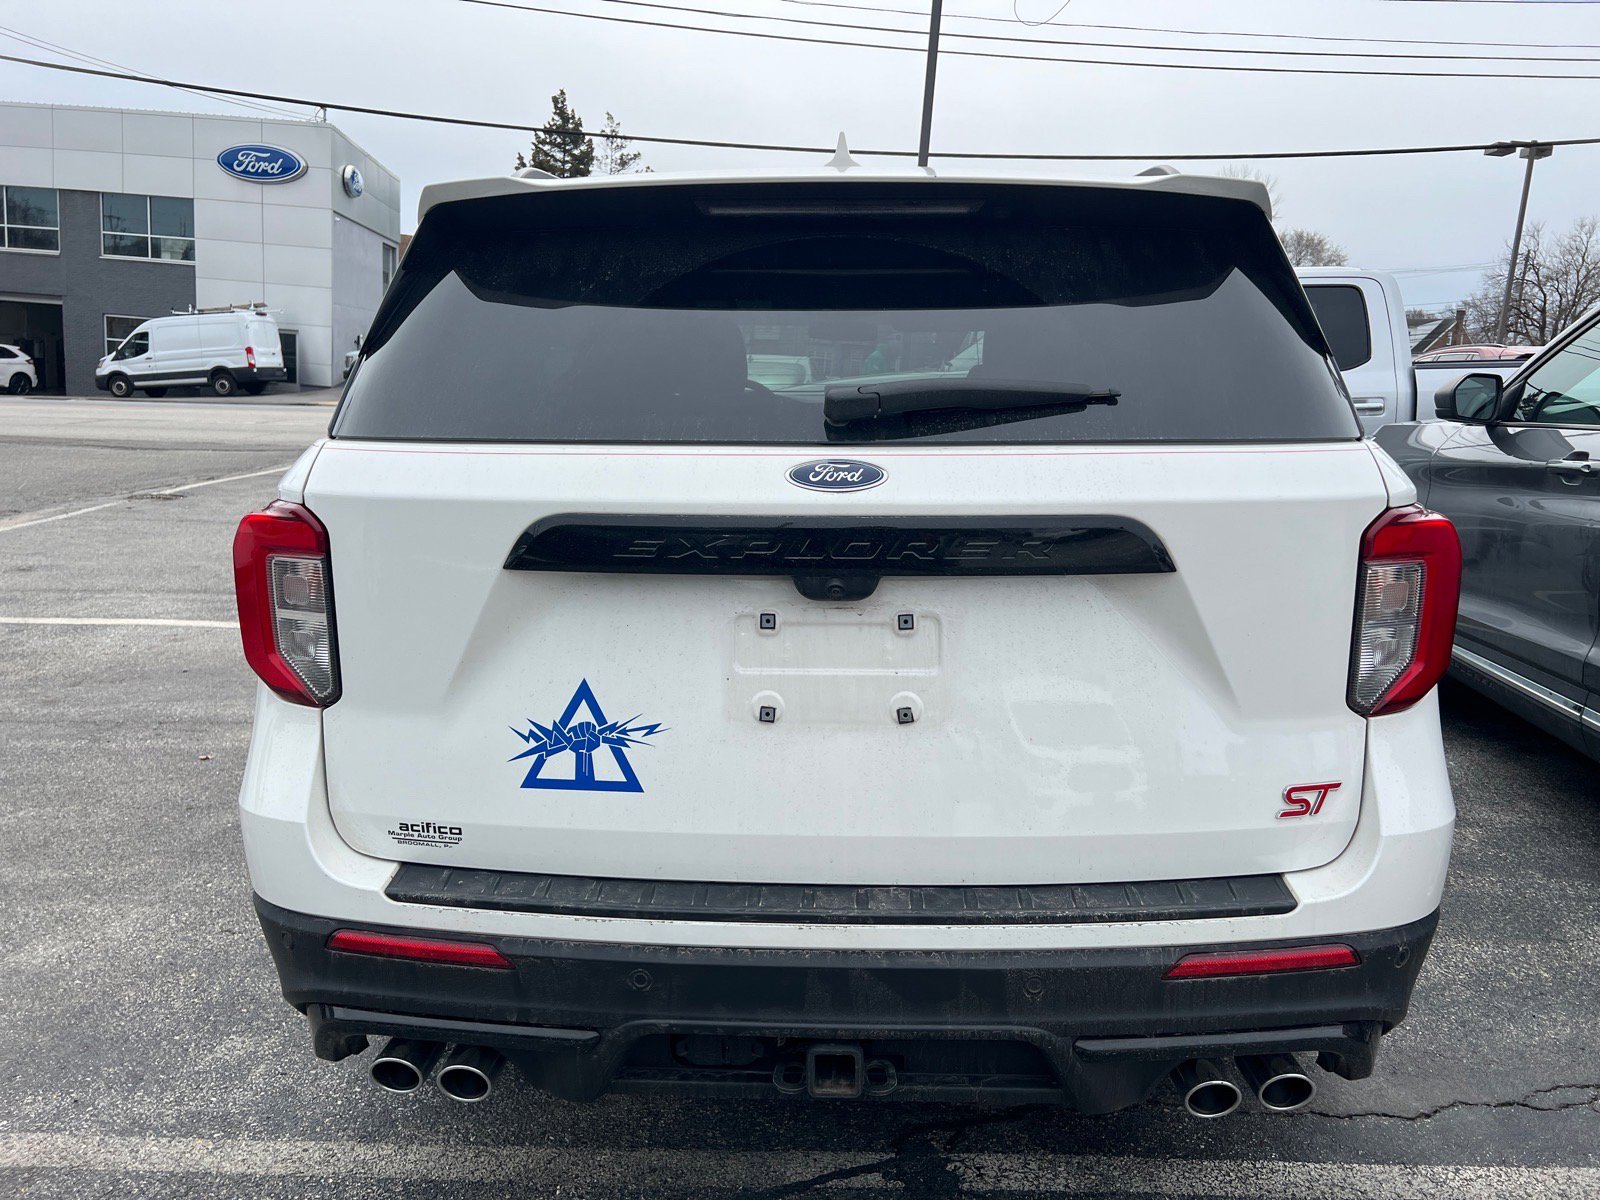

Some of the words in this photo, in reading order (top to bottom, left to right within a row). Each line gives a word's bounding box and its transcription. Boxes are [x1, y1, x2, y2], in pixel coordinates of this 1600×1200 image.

[233, 150, 283, 174] Ford
[808, 463, 864, 482] Ford
[612, 534, 1056, 560] EXPLORER
[1274, 780, 1342, 819] ST
[387, 830, 415, 838] Marple
[438, 834, 463, 842] Group
